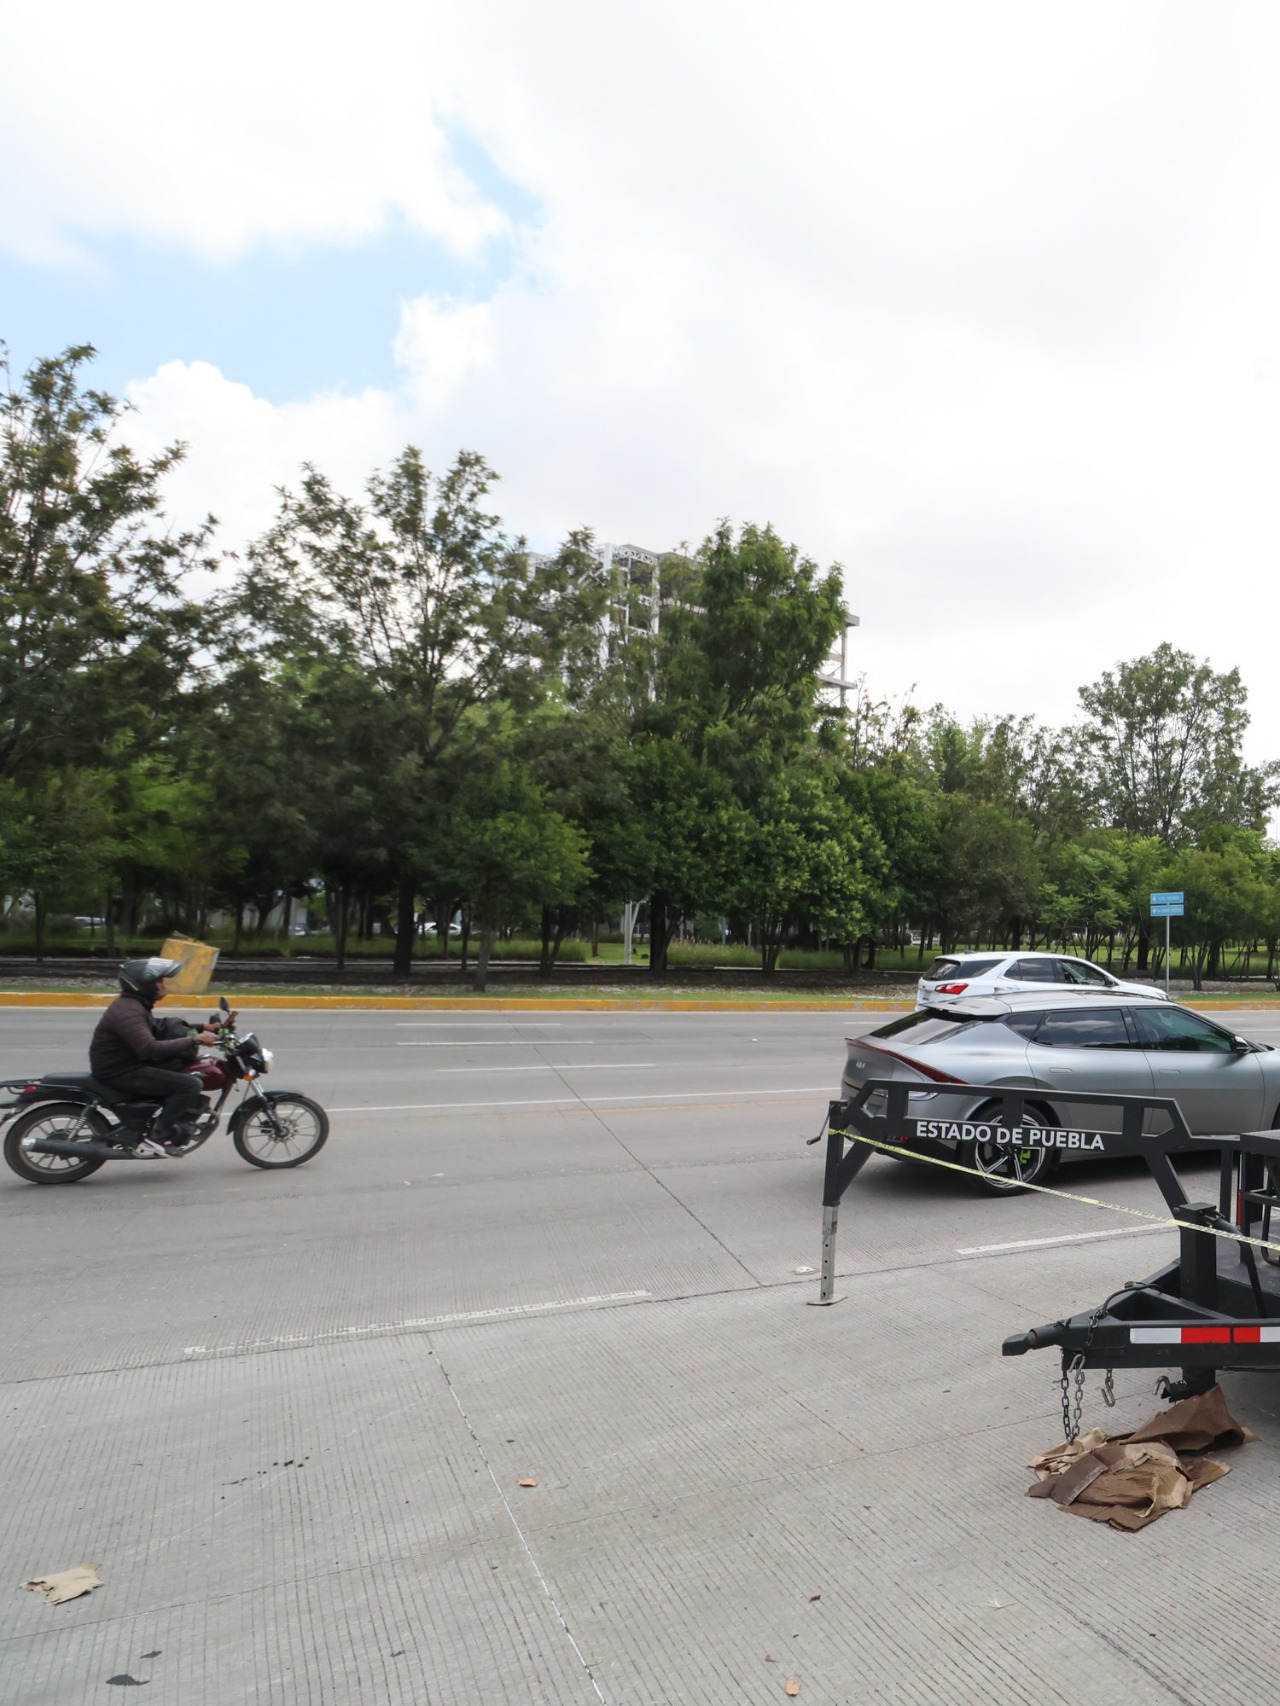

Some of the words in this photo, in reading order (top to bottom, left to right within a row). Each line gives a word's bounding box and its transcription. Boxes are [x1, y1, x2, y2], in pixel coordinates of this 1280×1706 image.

[916, 1121, 991, 1142] ESTADO
[996, 1127, 1023, 1144] DE
[1029, 1129, 1105, 1150] PUEBLA
